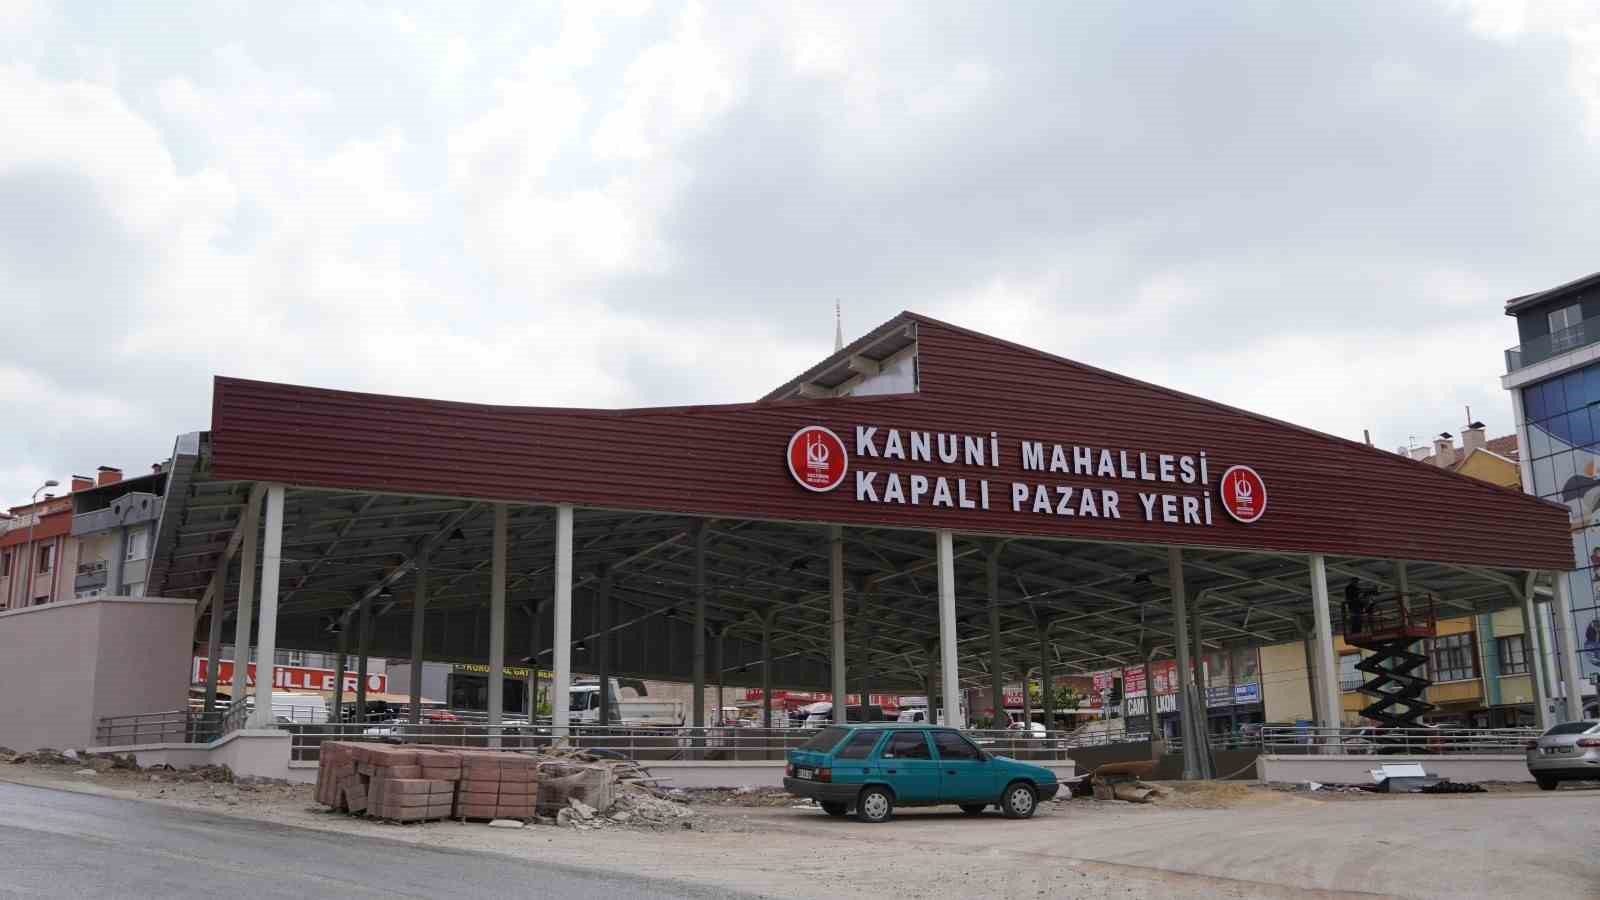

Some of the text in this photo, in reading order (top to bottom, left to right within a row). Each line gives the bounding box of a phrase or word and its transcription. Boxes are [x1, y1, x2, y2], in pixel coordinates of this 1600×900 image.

[856, 425, 1209, 485] KANUNİ MAHALLESİ
[856, 470, 1212, 525] KAPALI PAZAR YERİ
